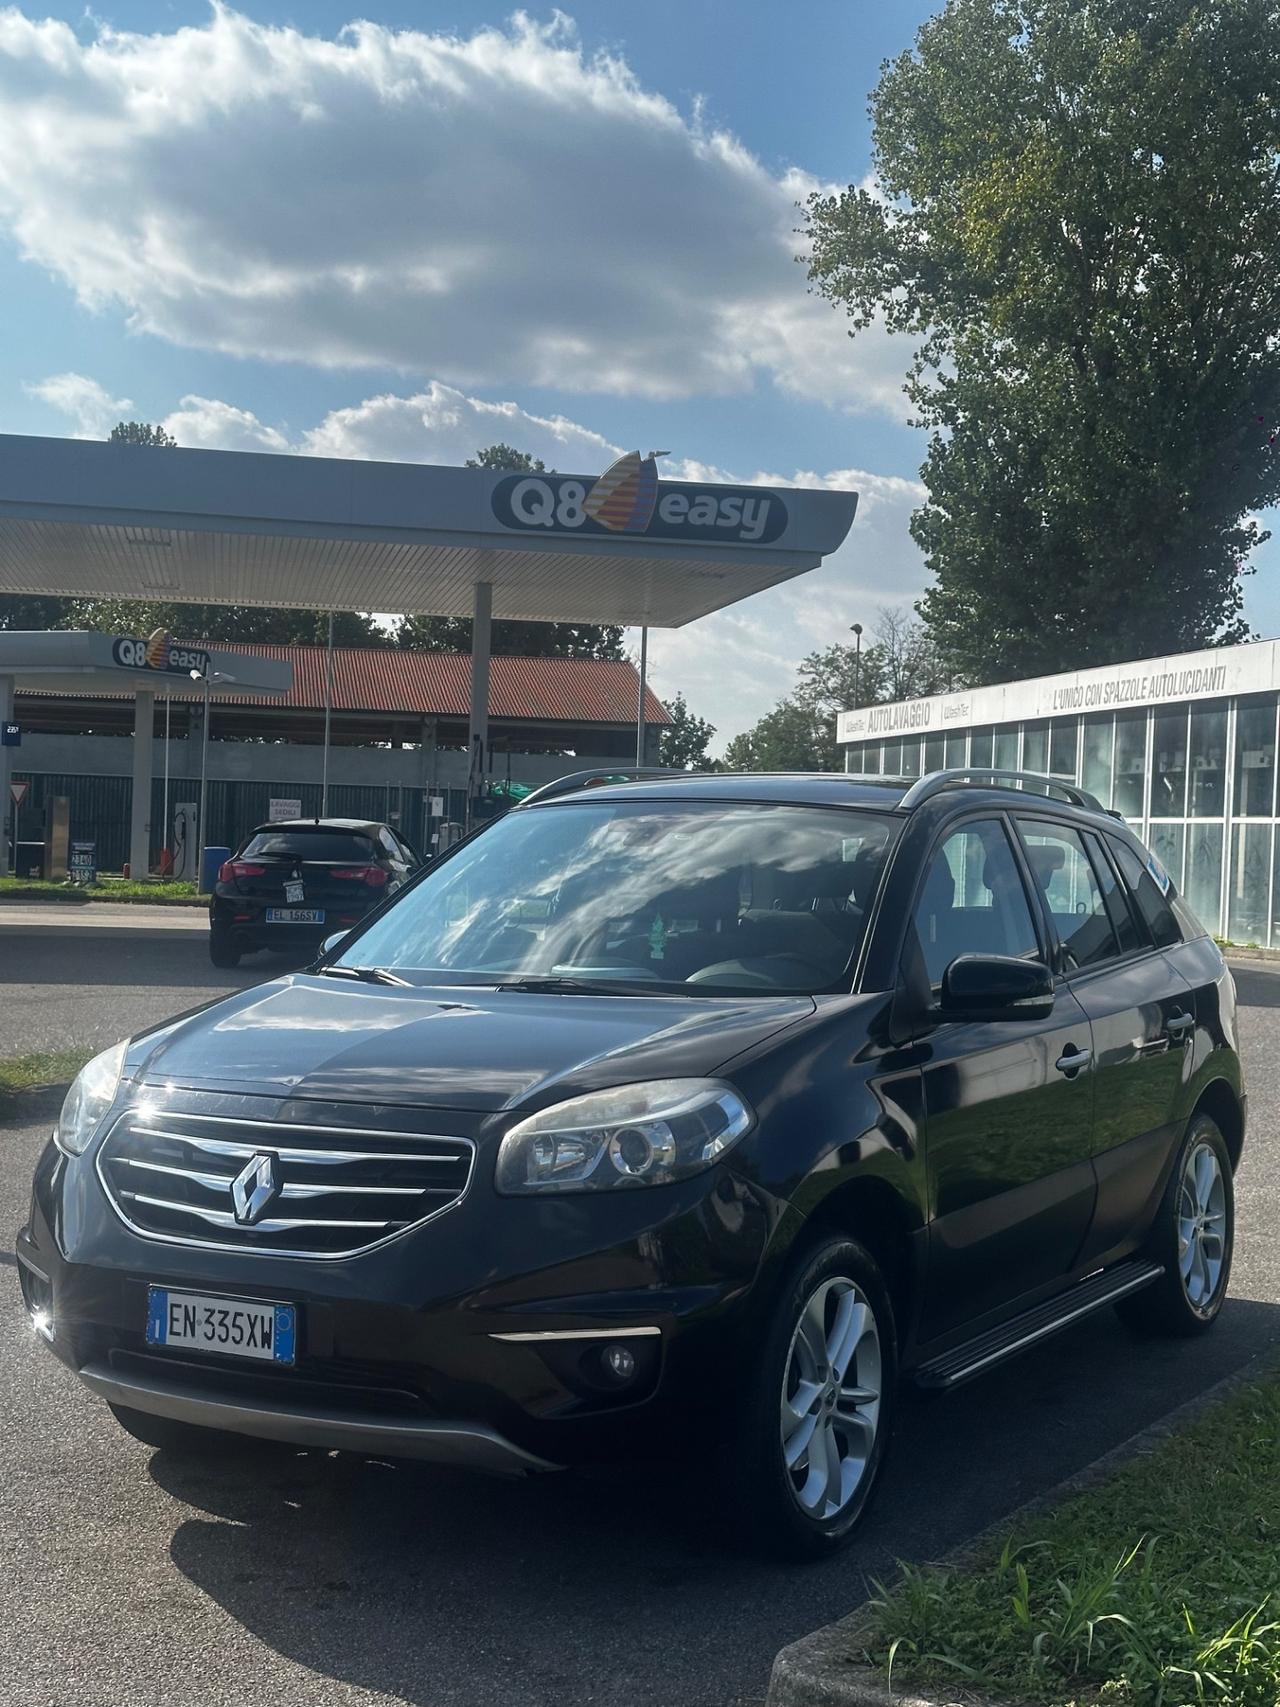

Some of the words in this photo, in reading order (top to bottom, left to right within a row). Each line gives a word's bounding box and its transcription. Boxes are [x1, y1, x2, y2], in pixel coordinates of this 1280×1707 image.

[510, 478, 587, 528] Q8
[658, 492, 771, 540] easy
[118, 640, 146, 666] Q8
[169, 649, 206, 676] easy
[1053, 685, 1084, 710] L'UNICO
[1085, 682, 1102, 706] CON
[1103, 677, 1148, 704] SPAZZOLE
[1149, 665, 1227, 699] AUTOLUCIDANTI
[867, 702, 931, 733] AUTOLAVAGGIO
[169, 1303, 196, 1338] EN
[203, 1307, 272, 1350] 335XW
